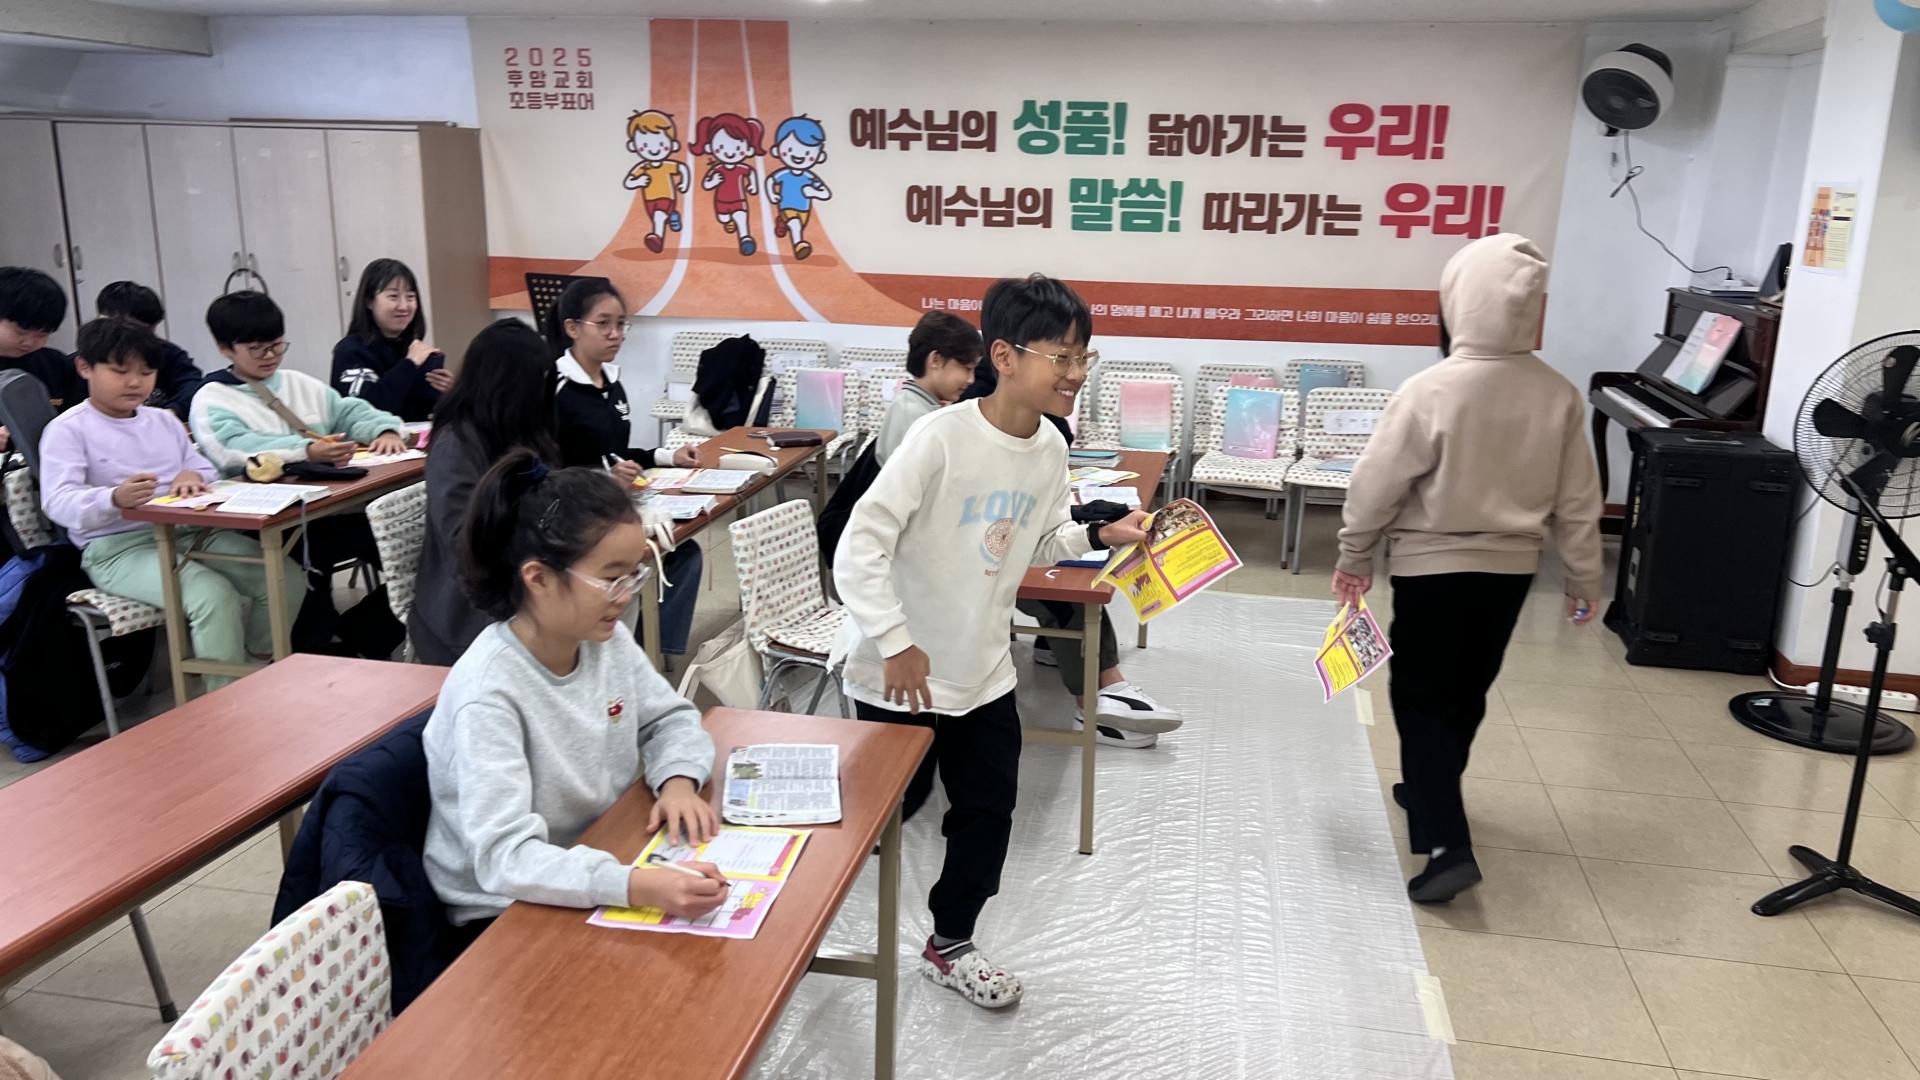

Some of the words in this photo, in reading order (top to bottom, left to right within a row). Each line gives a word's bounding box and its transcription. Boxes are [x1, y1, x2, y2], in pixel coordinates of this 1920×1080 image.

[504, 47, 592, 67] 2025
[506, 70, 593, 89] 후암교회
[850, 108, 997, 152] 예수님의
[1013, 99, 1128, 156] 성품!
[1149, 113, 1307, 158] 닮아가는
[1325, 102, 1450, 160] 우리!
[906, 184, 1053, 229] 예수님의
[1069, 177, 1184, 233] 말씀!
[1202, 192, 1362, 237] 따라가는
[1380, 182, 1505, 240] 우리!
[921, 297, 945, 310] 나는
[1203, 307, 1242, 320] 배우라
[1296, 310, 1323, 323] 너희
[1325, 311, 1363, 324] 마음이
